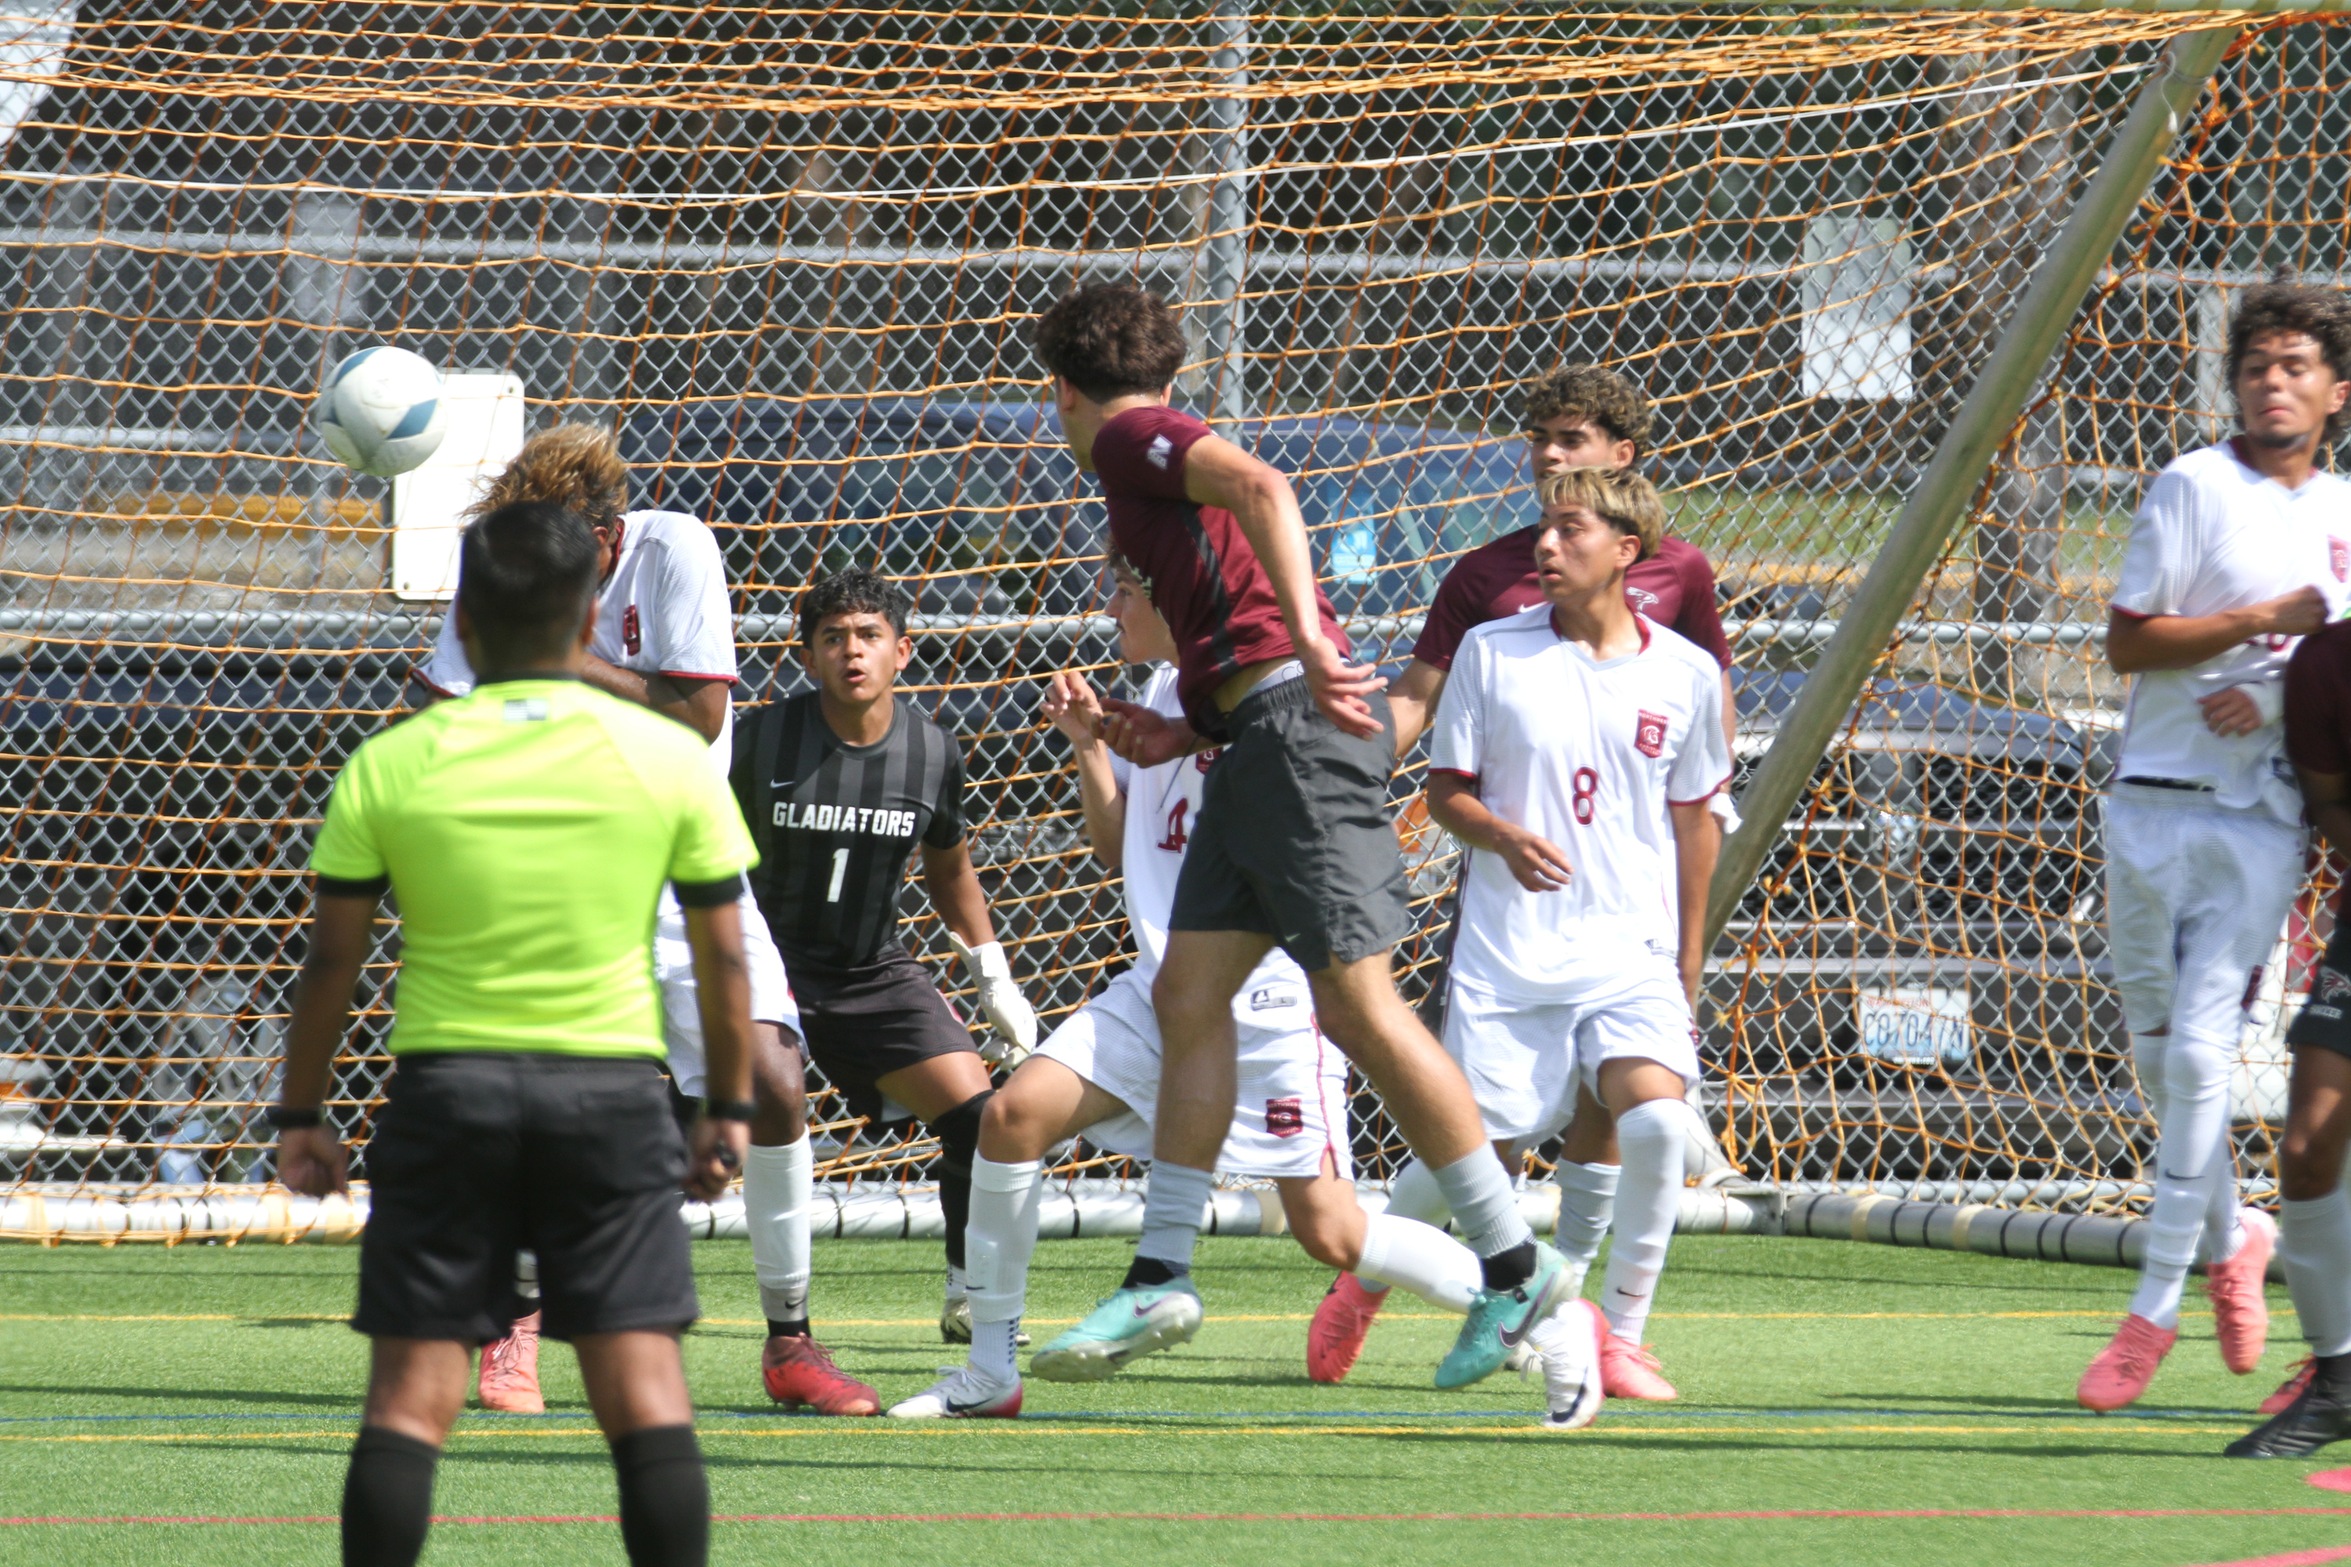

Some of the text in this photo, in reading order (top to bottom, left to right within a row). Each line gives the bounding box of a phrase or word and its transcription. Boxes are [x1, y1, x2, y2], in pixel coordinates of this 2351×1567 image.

[772, 801, 916, 838] GLADIATORS
[1572, 766, 1599, 825] 8
[827, 848, 850, 903] 1
